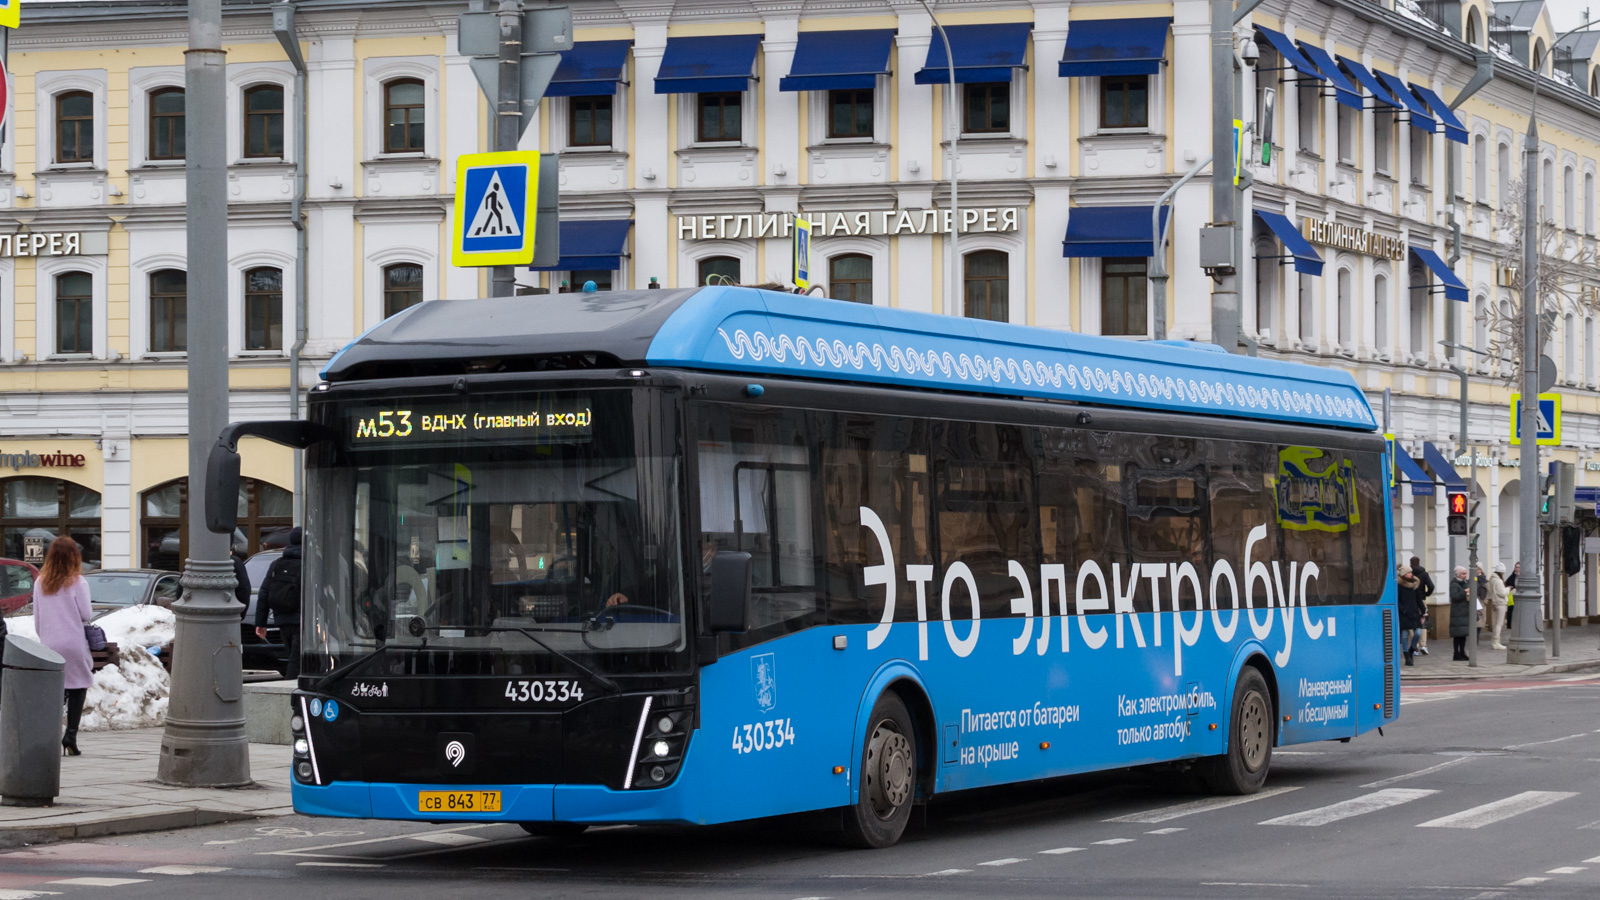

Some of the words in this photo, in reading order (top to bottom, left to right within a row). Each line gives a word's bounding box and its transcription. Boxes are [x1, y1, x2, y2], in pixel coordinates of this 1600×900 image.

[678, 211, 870, 240] НЕГЛИННАЯ
[882, 207, 1018, 235] ГАЛЕРЕЯ
[0, 232, 80, 257] ЛЕРЕЯ
[1310, 218, 1367, 252] НЕГЛИННАЯ
[1369, 232, 1405, 260] ГАЛЕРЕЯ
[421, 413, 467, 432] ВДНХ
[473, 410, 540, 430] (главный
[546, 408, 592, 427] вход)
[0, 450, 85, 471] mplewine
[860, 506, 981, 661] Это
[1008, 522, 1336, 676] электробус.
[505, 681, 584, 702] 430334
[1299, 674, 1352, 700] Маневренный
[1118, 694, 1137, 717] Как
[1139, 686, 1217, 716] электромобиль,
[1299, 709, 1304, 723] и
[1305, 700, 1348, 726] бесшумный
[961, 708, 1016, 734] Питается
[1018, 709, 1032, 727] от
[1033, 701, 1080, 729] батареи
[1117, 725, 1151, 746] только
[1153, 715, 1191, 743] автобус
[732, 718, 795, 754] 430334
[960, 746, 975, 766] на
[977, 741, 1019, 768] крыше
[447, 794, 474, 809] 843
[482, 793, 496, 805] 77
